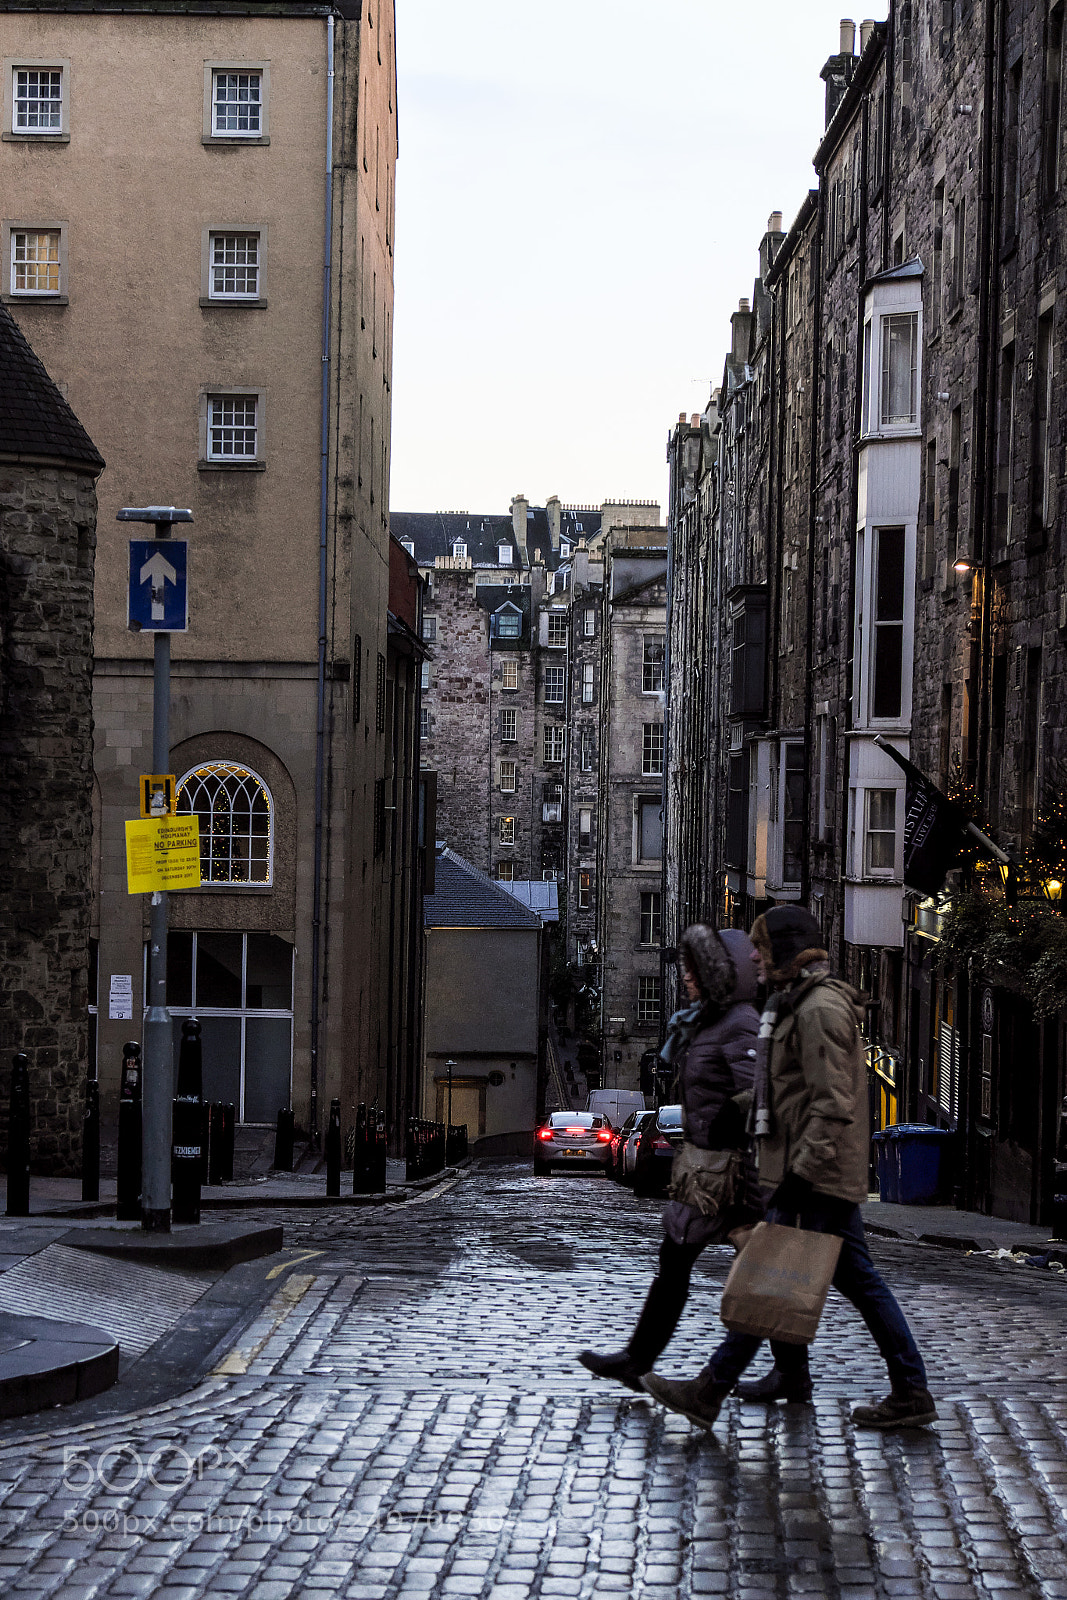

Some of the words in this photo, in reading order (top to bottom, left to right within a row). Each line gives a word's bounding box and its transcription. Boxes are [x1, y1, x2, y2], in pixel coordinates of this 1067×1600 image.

[157, 826, 193, 834] EDINBURGH'S
[915, 823, 929, 842] LIVE
[167, 838, 197, 848] PARKING
